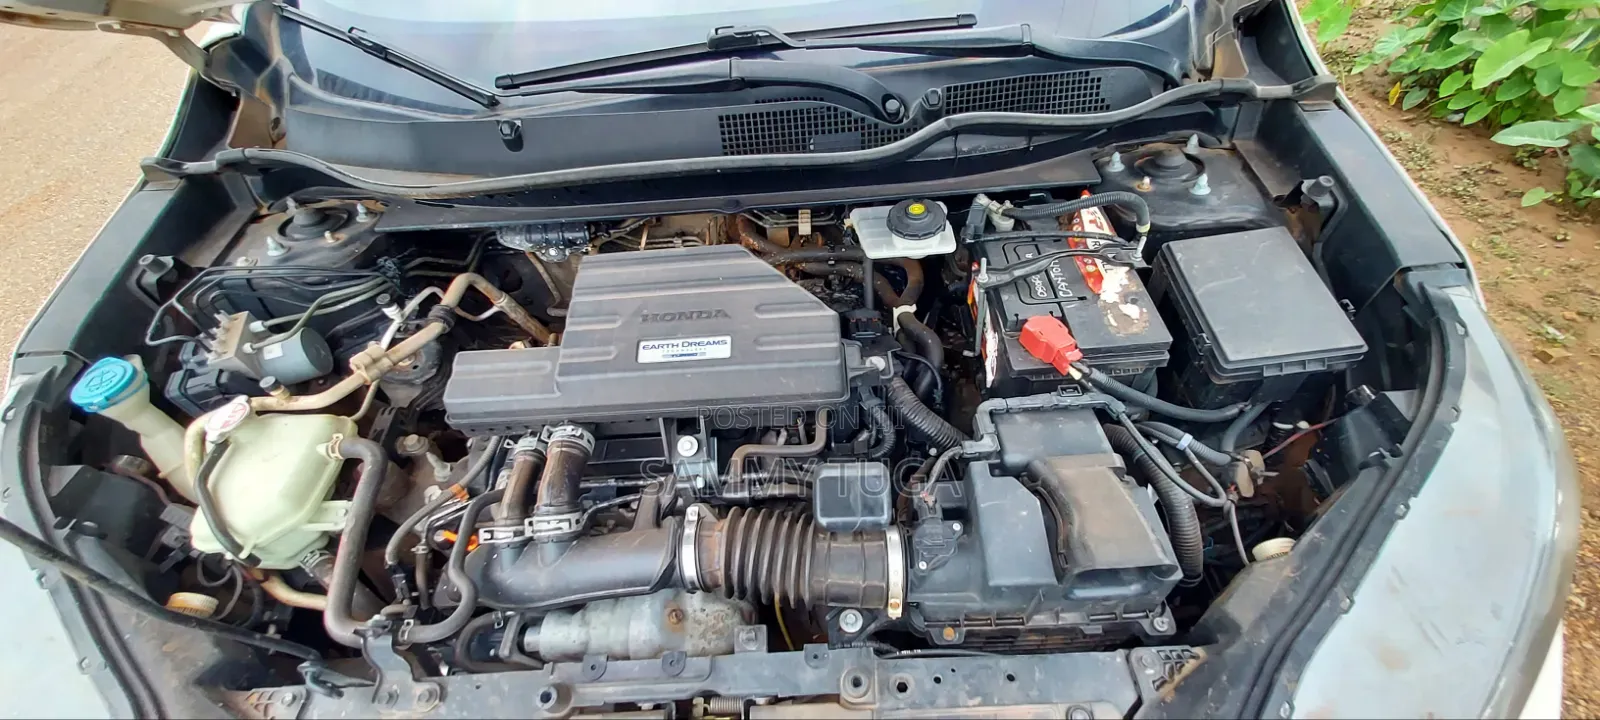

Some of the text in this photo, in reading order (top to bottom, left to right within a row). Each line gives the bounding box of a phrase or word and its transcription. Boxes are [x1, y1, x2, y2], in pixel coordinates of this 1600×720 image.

[640, 309, 732, 322] HONDA
[642, 339, 728, 350] EARTH DREAMS
